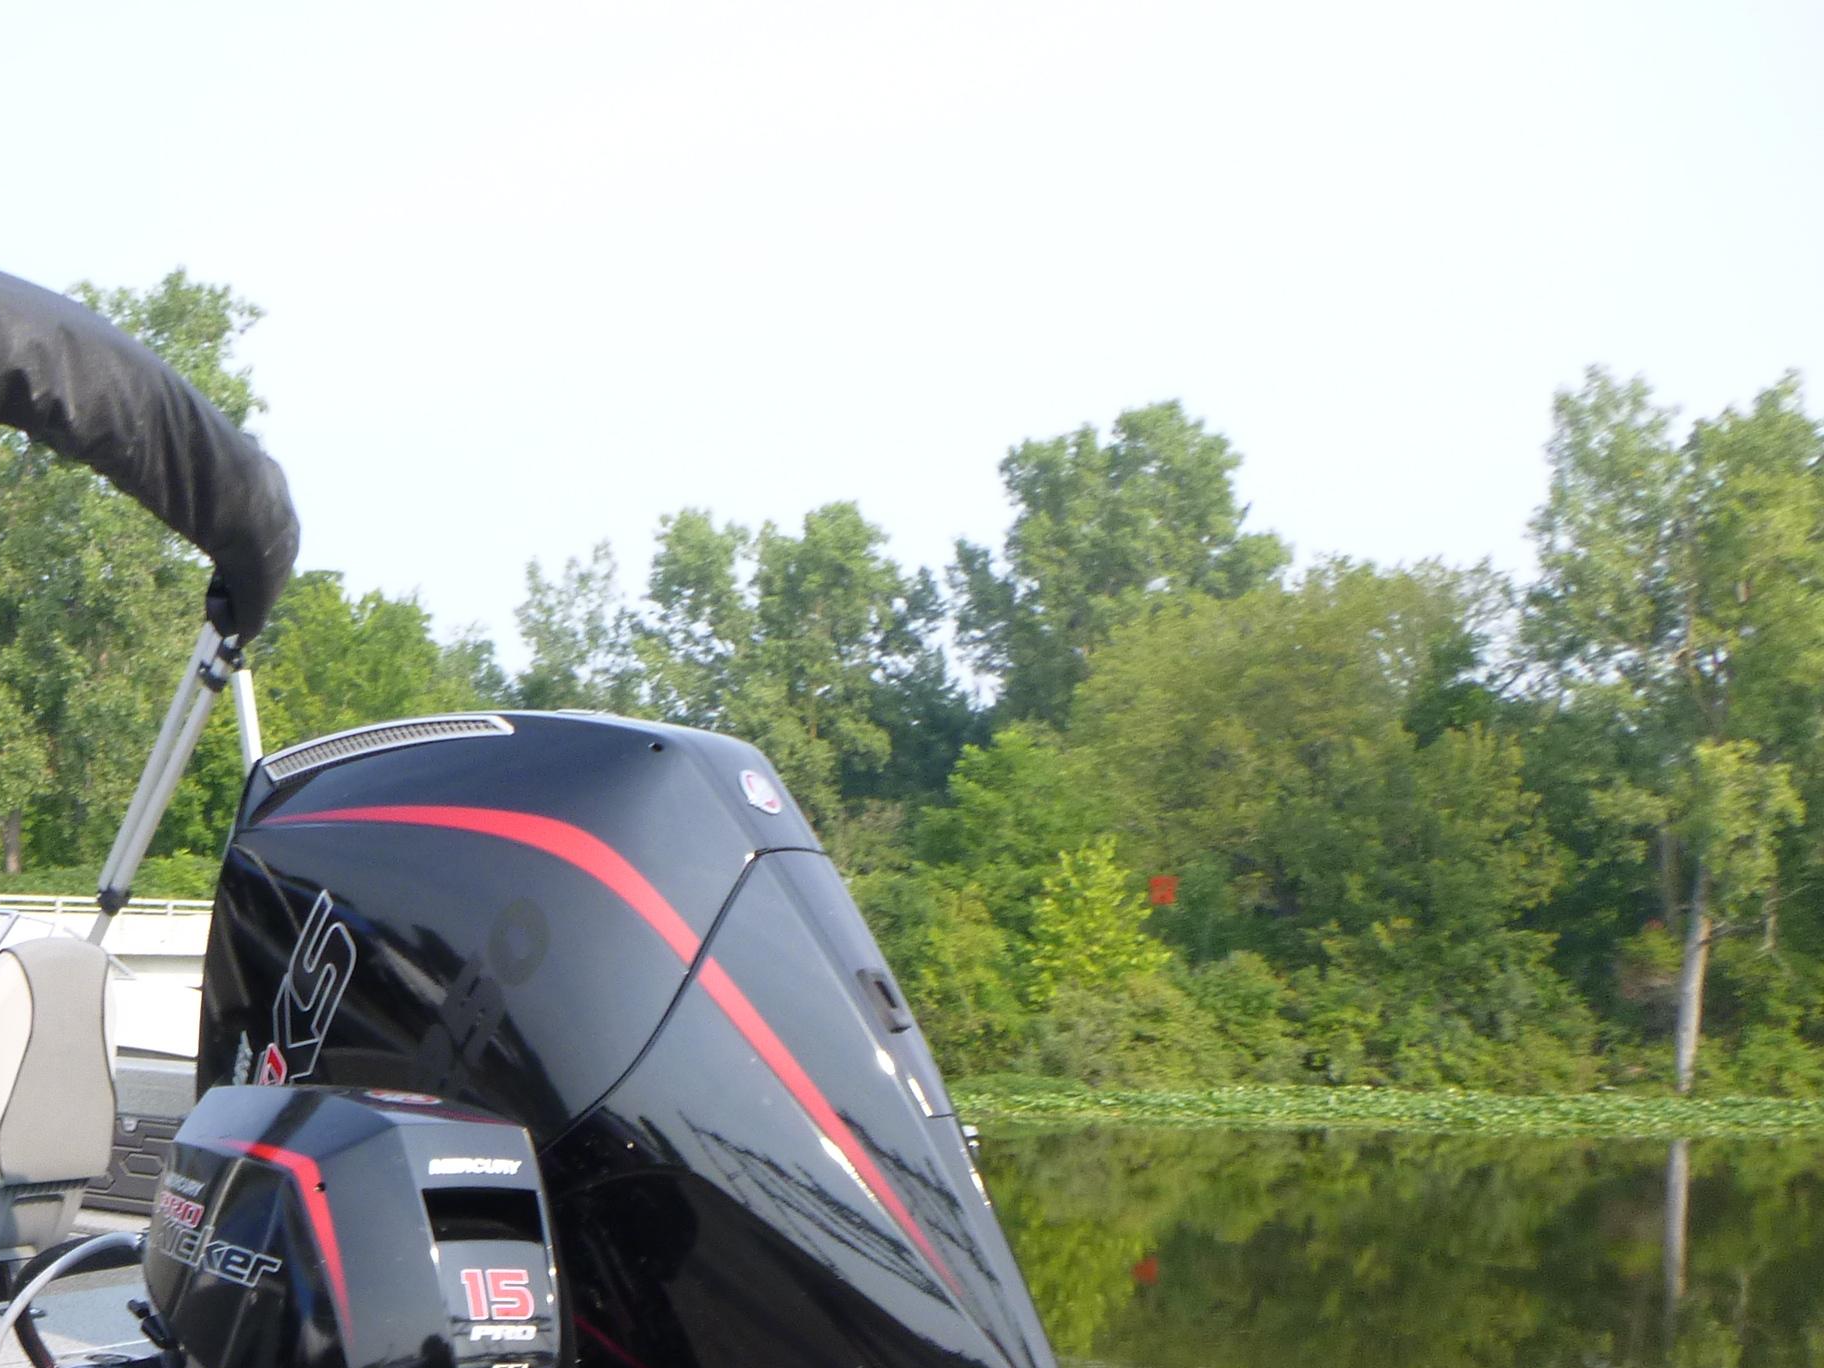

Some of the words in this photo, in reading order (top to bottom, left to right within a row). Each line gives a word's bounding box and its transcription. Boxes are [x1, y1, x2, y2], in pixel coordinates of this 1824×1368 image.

[428, 1157, 522, 1175] MERCURY
[460, 1268, 535, 1320] 15
[470, 1325, 537, 1341] PRO
